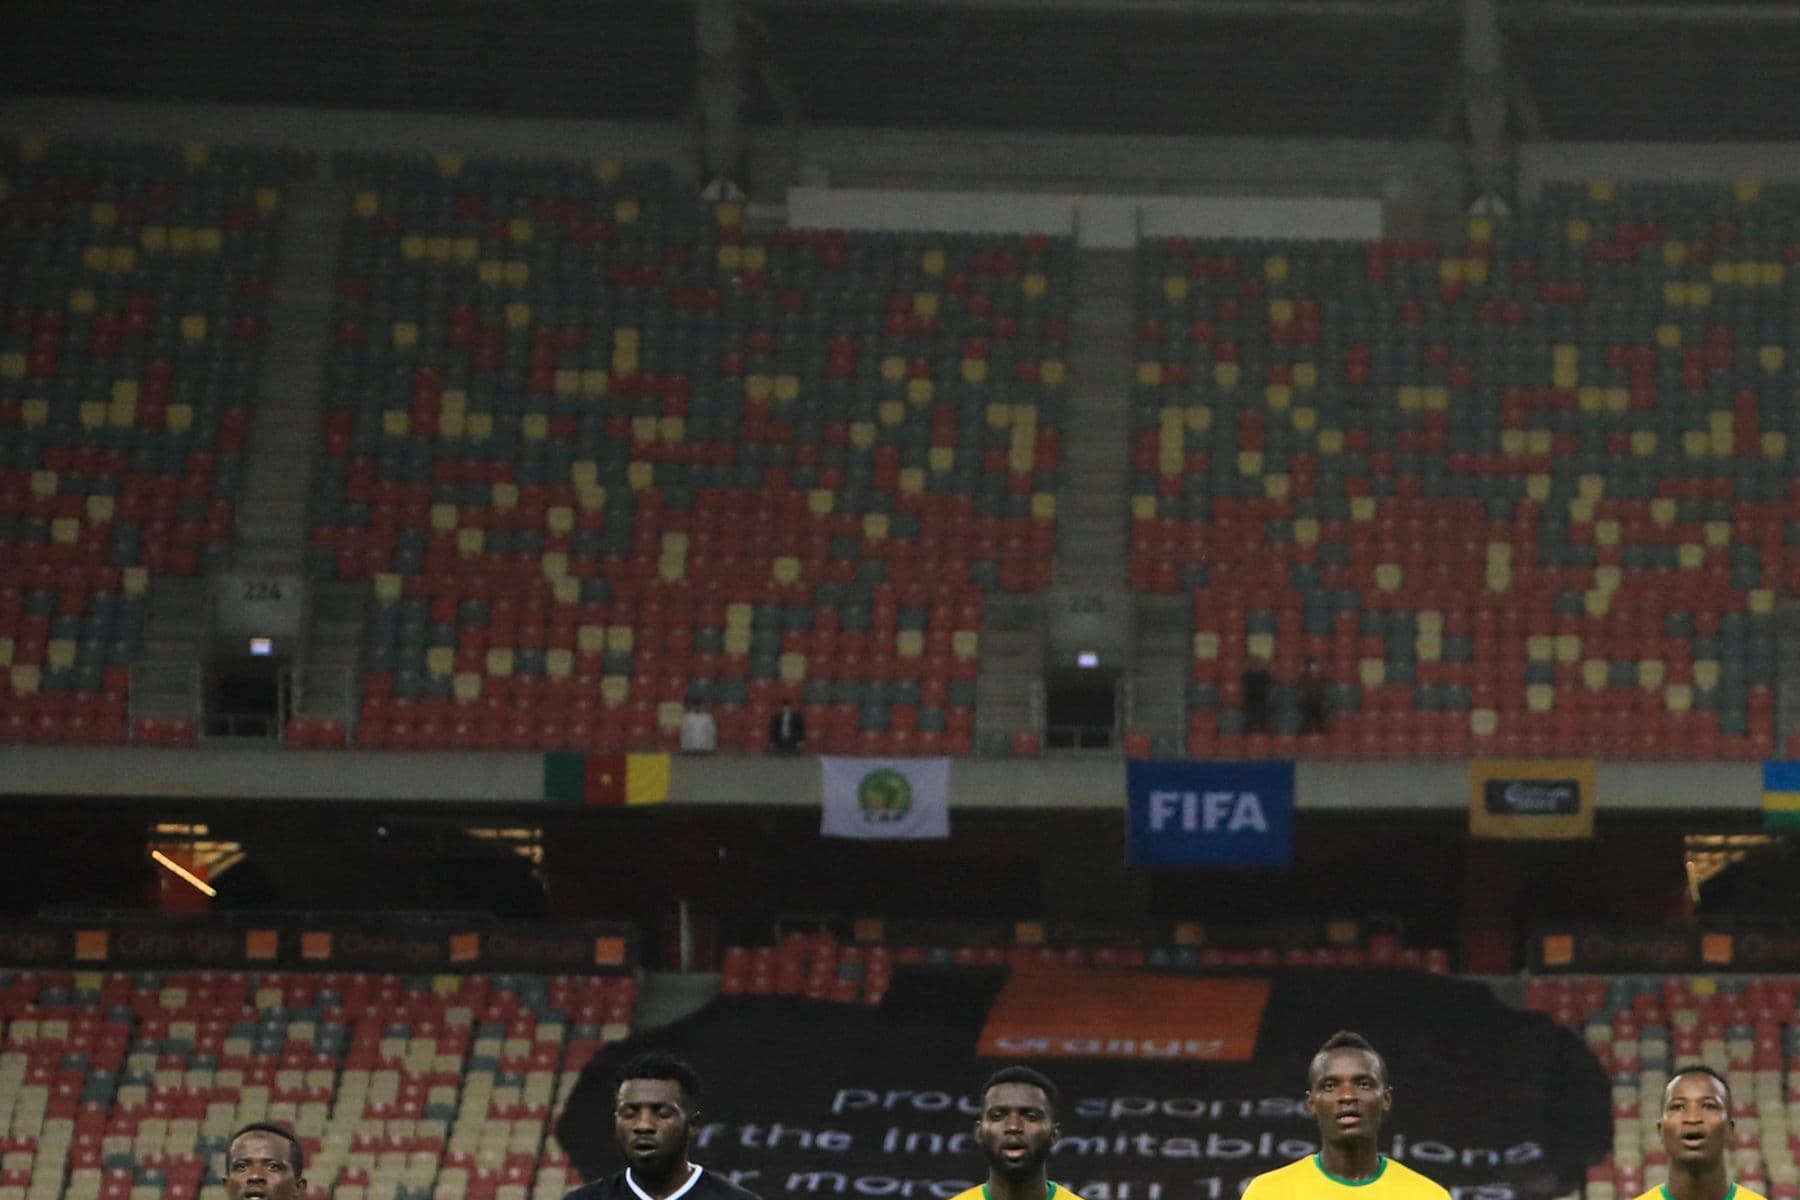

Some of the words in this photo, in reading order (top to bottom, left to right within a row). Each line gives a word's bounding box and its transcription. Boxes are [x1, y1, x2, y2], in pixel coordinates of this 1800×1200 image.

[1150, 789, 1269, 831] FIFA
[832, 1089, 983, 1115] prou
[739, 1123, 853, 1151] the
